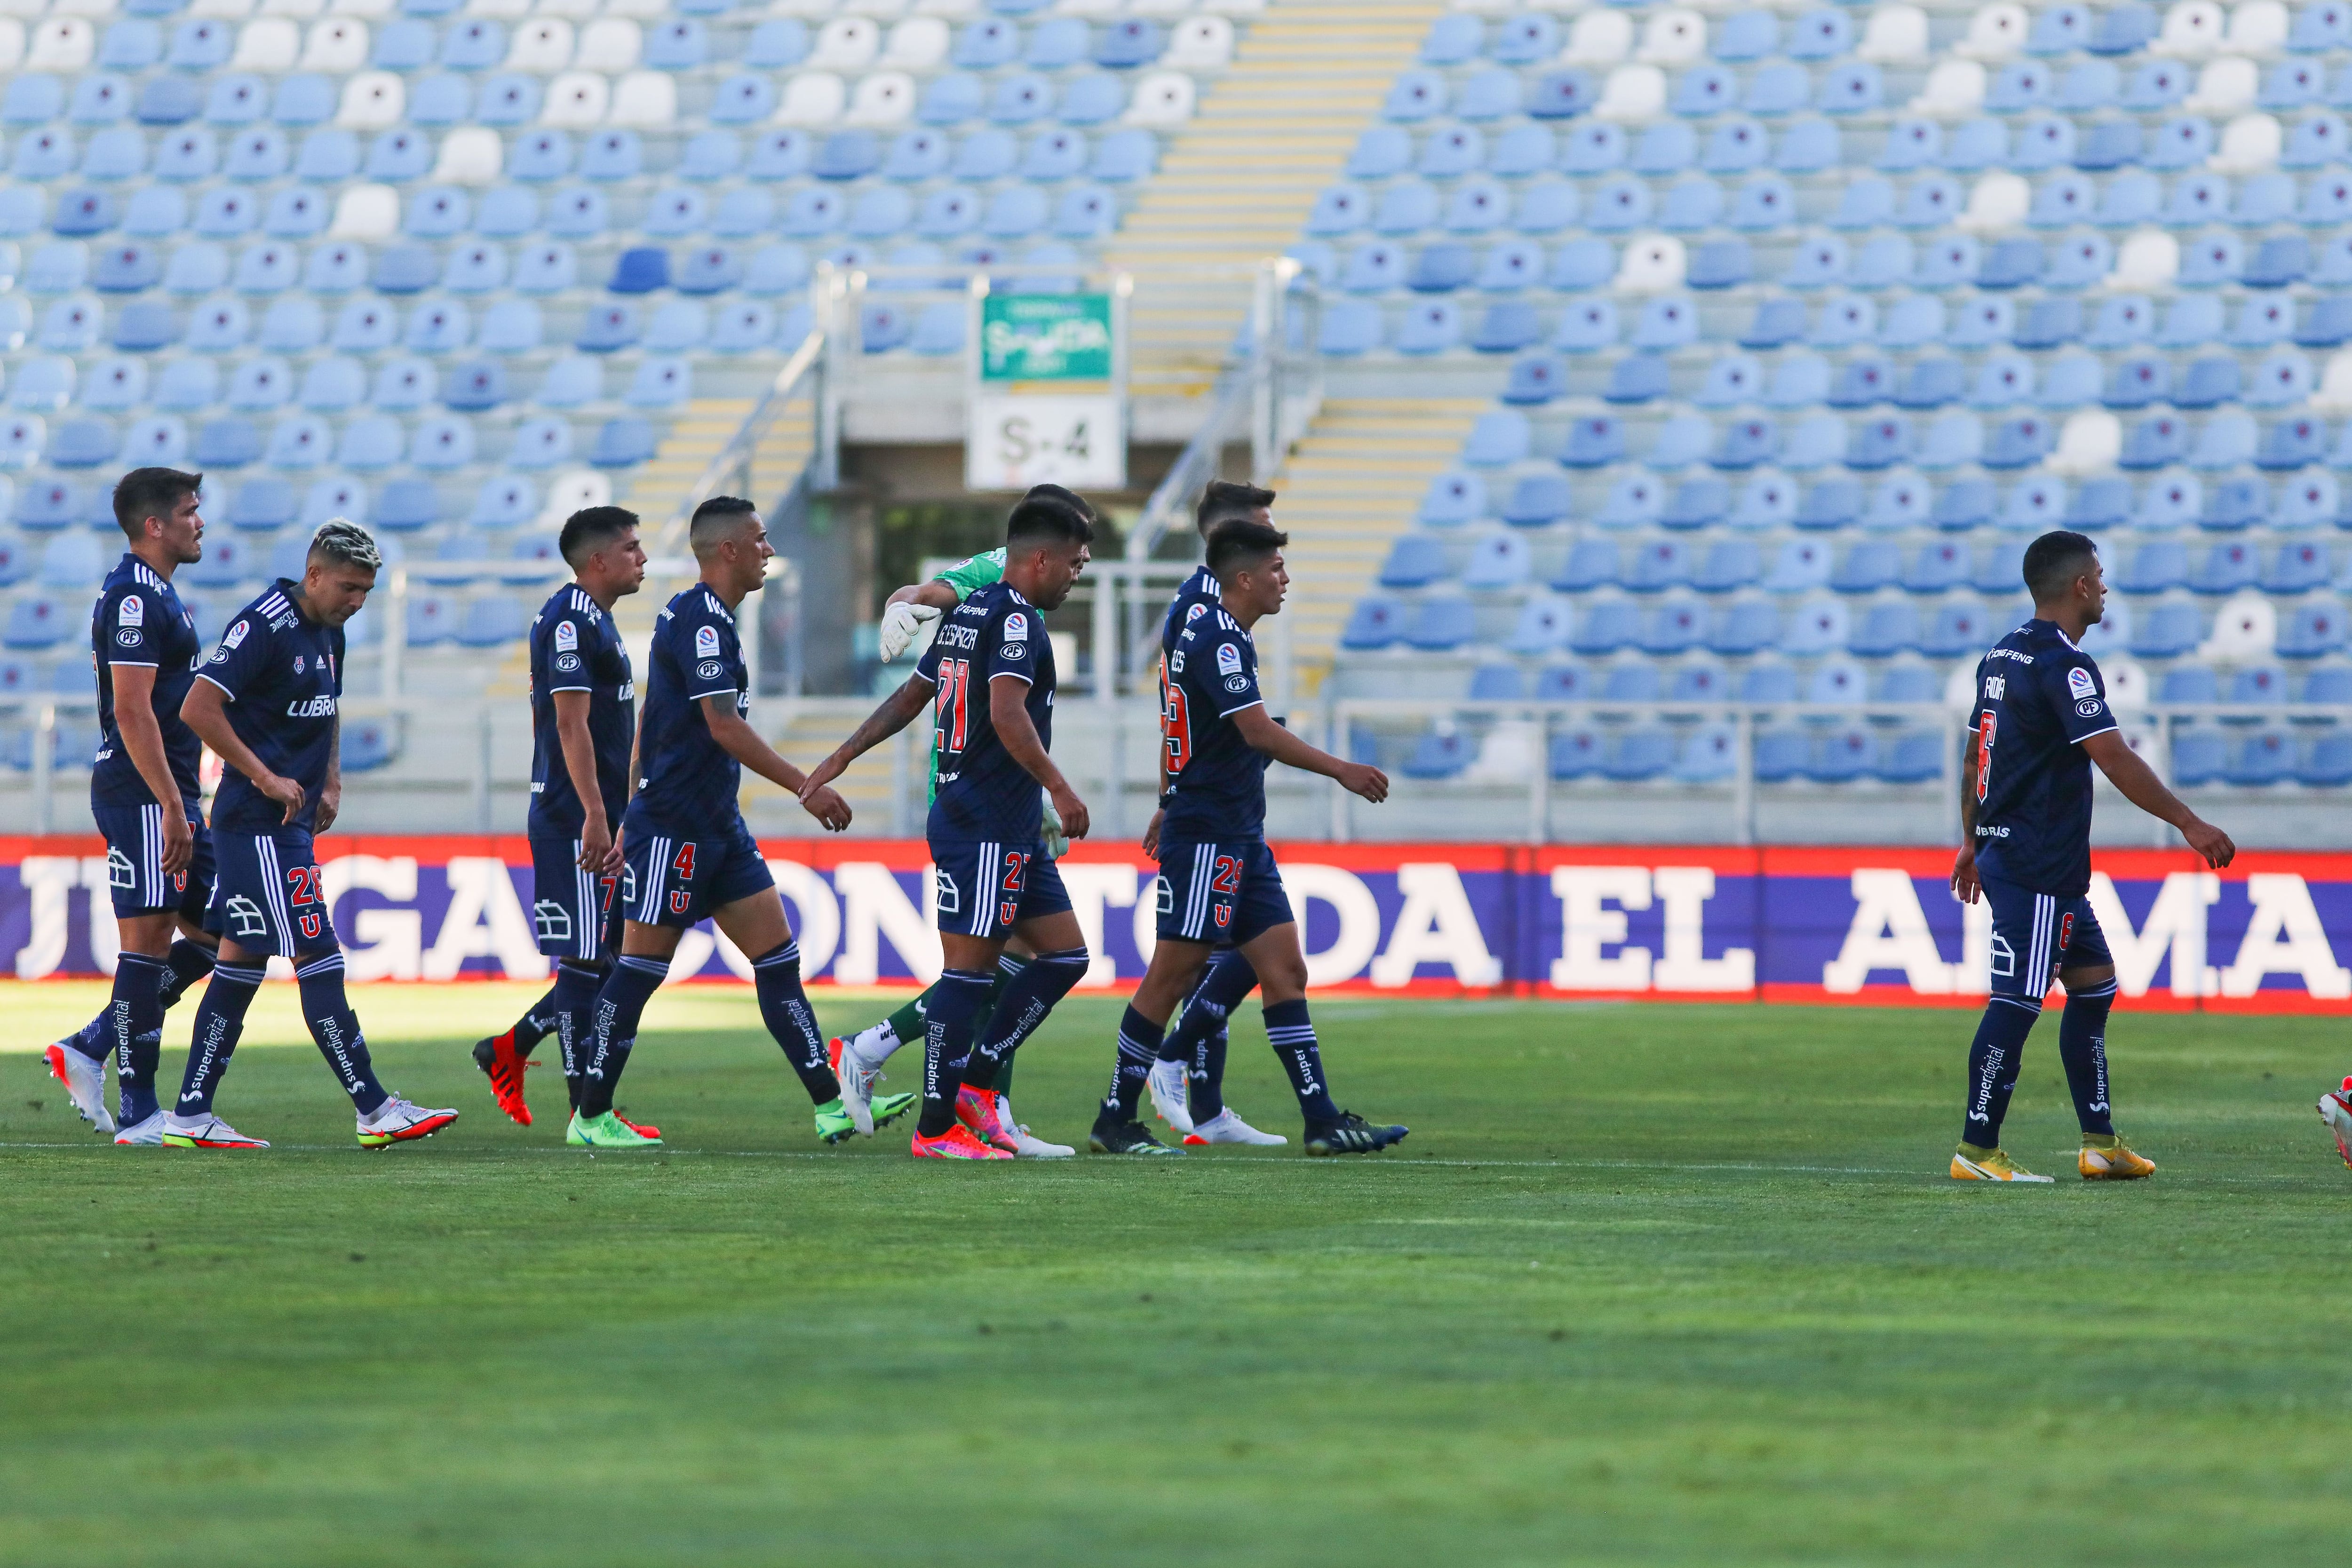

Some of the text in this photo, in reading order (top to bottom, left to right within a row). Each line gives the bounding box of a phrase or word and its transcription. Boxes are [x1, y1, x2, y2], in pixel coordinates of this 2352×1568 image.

[123, 631, 136, 643] PF
[270, 609, 294, 633] DIRECTV
[288, 617, 299, 628] GO
[213, 651, 224, 660] PF
[562, 658, 574, 667] PF
[704, 664, 715, 675] PF
[1006, 645, 1020, 656] PF
[1231, 677, 1244, 689] PF
[936, 657, 969, 754] 21
[2082, 702, 2095, 713] PF
[673, 842, 696, 880] 4
[1212, 854, 1244, 895] 29
[287, 865, 325, 907] 28
[600, 876, 617, 913] 7
[670, 890, 691, 914] U
[299, 913, 321, 939] U
[1000, 901, 1017, 925] U
[1215, 903, 1232, 927] U
[1550, 865, 1755, 991] EL
[2059, 912, 2074, 951] 6
[113, 999, 133, 1067] superdigital
[558, 1011, 576, 1069] superdigital
[594, 998, 618, 1067] superdigital
[782, 998, 819, 1059] superdigital
[994, 996, 1046, 1053] superdigital
[191, 1012, 228, 1090] superdigital
[317, 1015, 356, 1082] superdigital
[927, 1020, 946, 1092] superdigital
[1977, 1044, 2005, 1112] superdigital
[2090, 1036, 2106, 1101] superdigital
